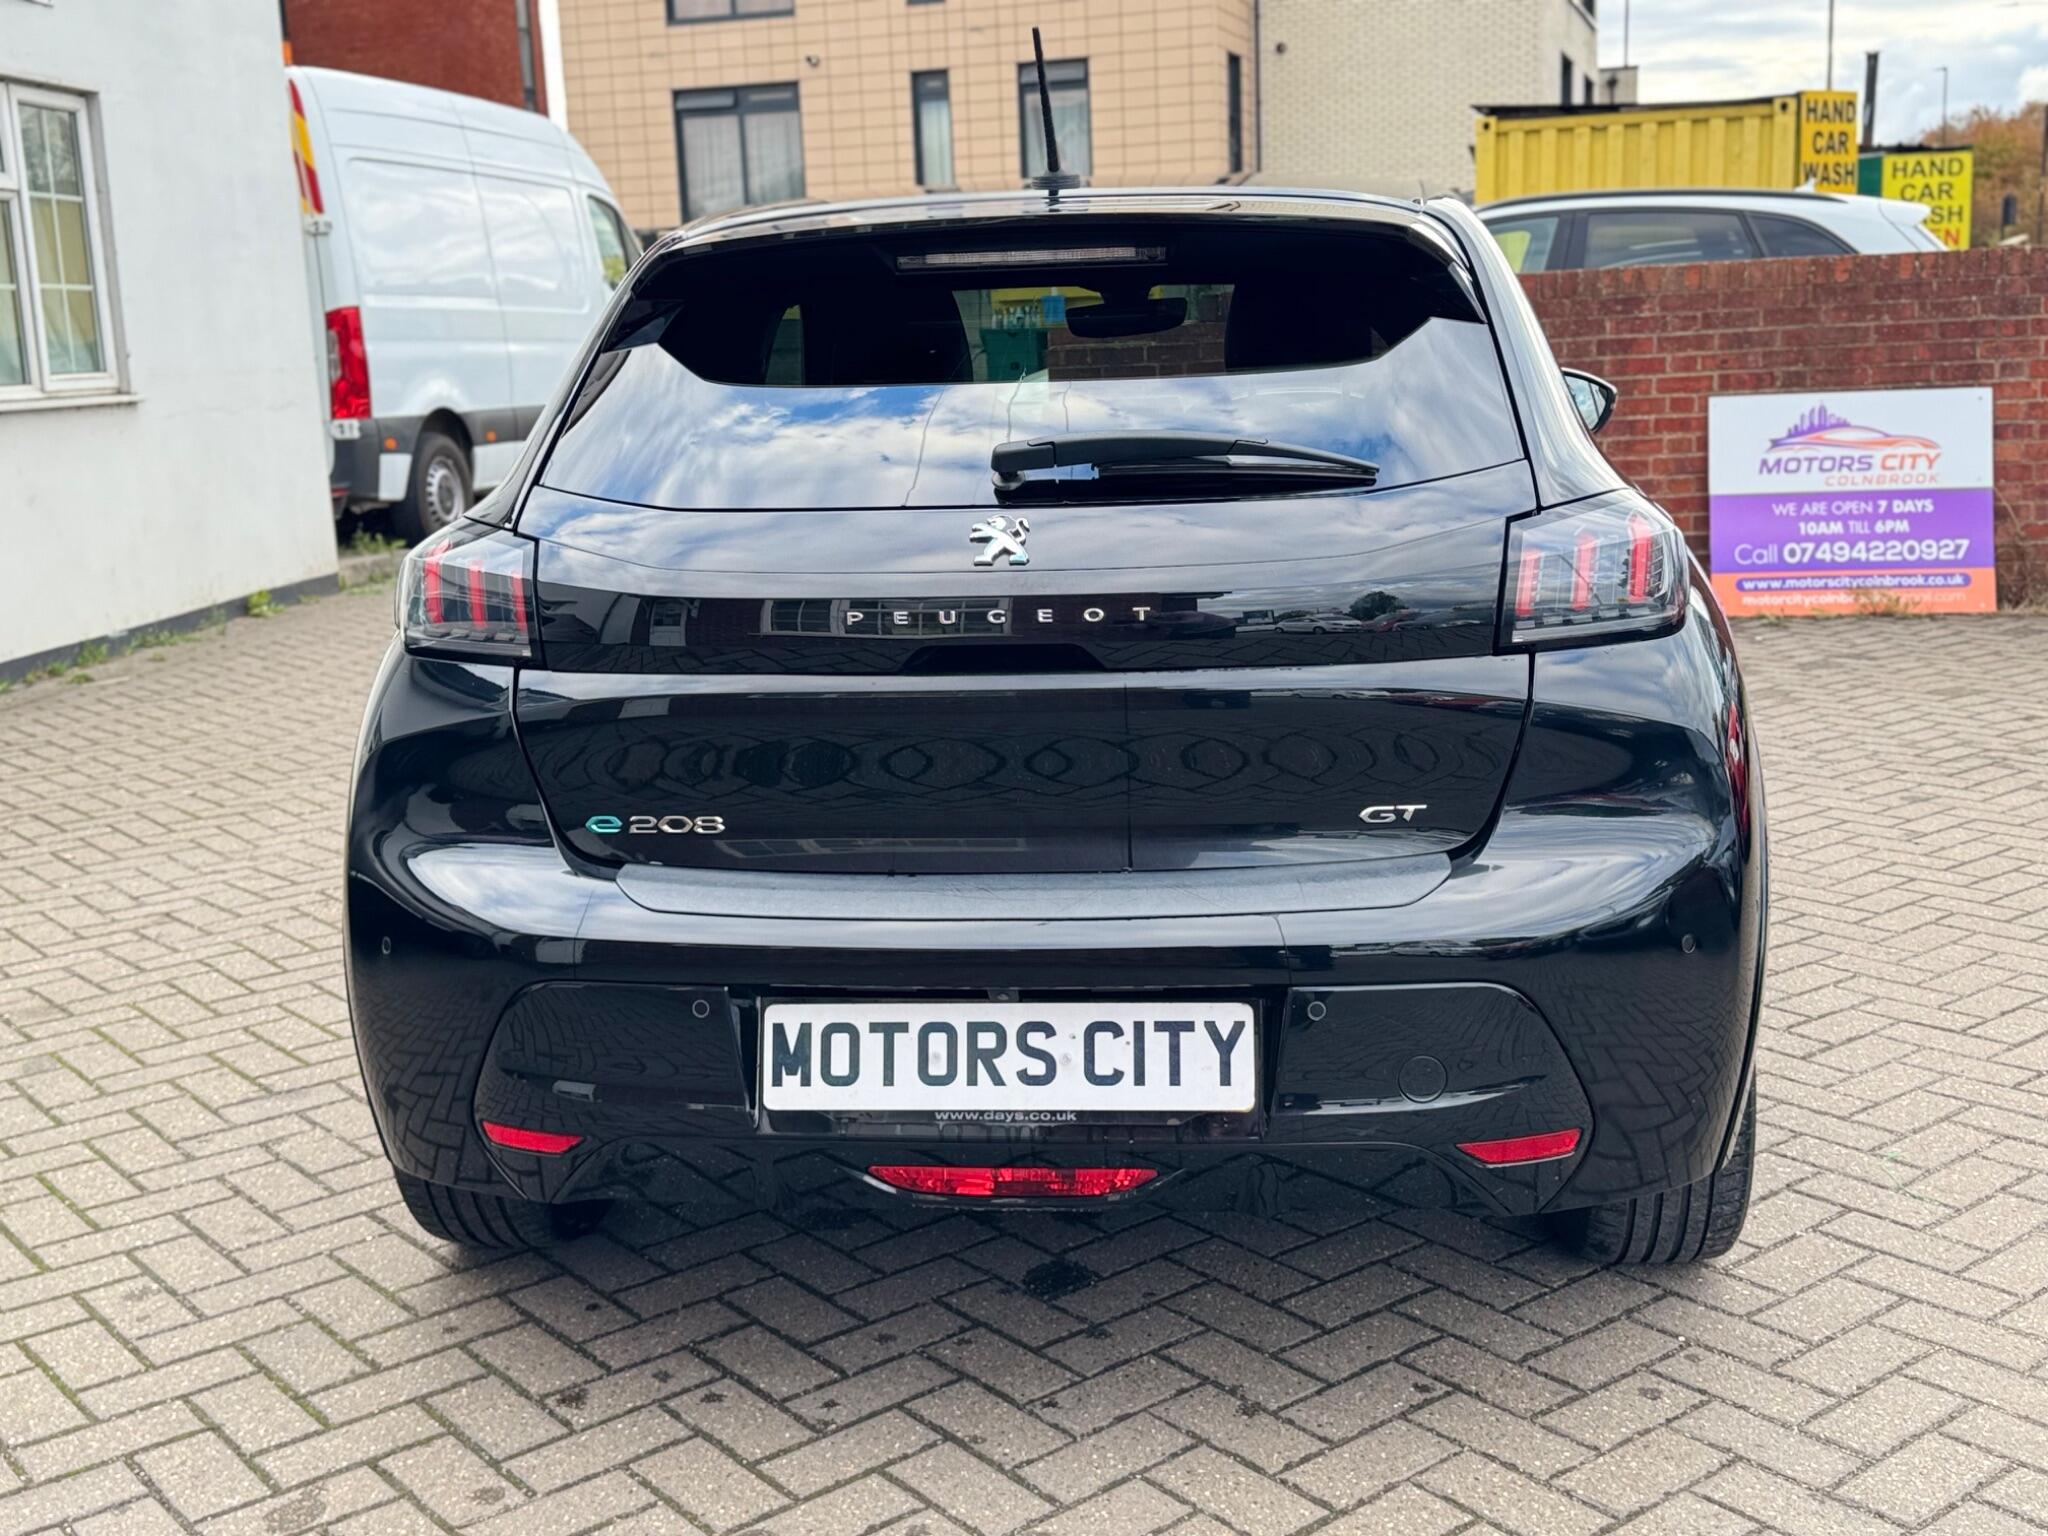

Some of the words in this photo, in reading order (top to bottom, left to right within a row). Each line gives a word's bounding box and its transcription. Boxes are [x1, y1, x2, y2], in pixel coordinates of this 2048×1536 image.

[1806, 99, 1856, 124] HAND
[1812, 131, 1849, 155] CAR
[1802, 162, 1856, 186] WASH
[1891, 157, 1964, 179] HAND
[1900, 181, 1954, 202] CAR
[1759, 454, 1873, 475] MOTORS
[1879, 452, 1942, 472] CITY
[1824, 472, 1940, 487] COLNBROOK
[1772, 502, 1796, 516] WE
[1801, 502, 1827, 516] ARE
[1831, 501, 1873, 515] OPEN
[1877, 499, 1888, 513] 7
[1892, 499, 1934, 513] DAYS
[1798, 521, 1844, 535] 10AM
[1848, 520, 1870, 534] TILL
[1874, 519, 1910, 534] 6PM
[1734, 543, 1778, 565] Call
[1782, 539, 1970, 564] 07494220927
[847, 607, 1151, 625] PEUGEOT
[1359, 804, 1427, 823] GT
[771, 1020, 1058, 1088] MOTORS
[1083, 1019, 1247, 1087] CITY
[934, 1110, 1078, 1123] www.days.co.uk
